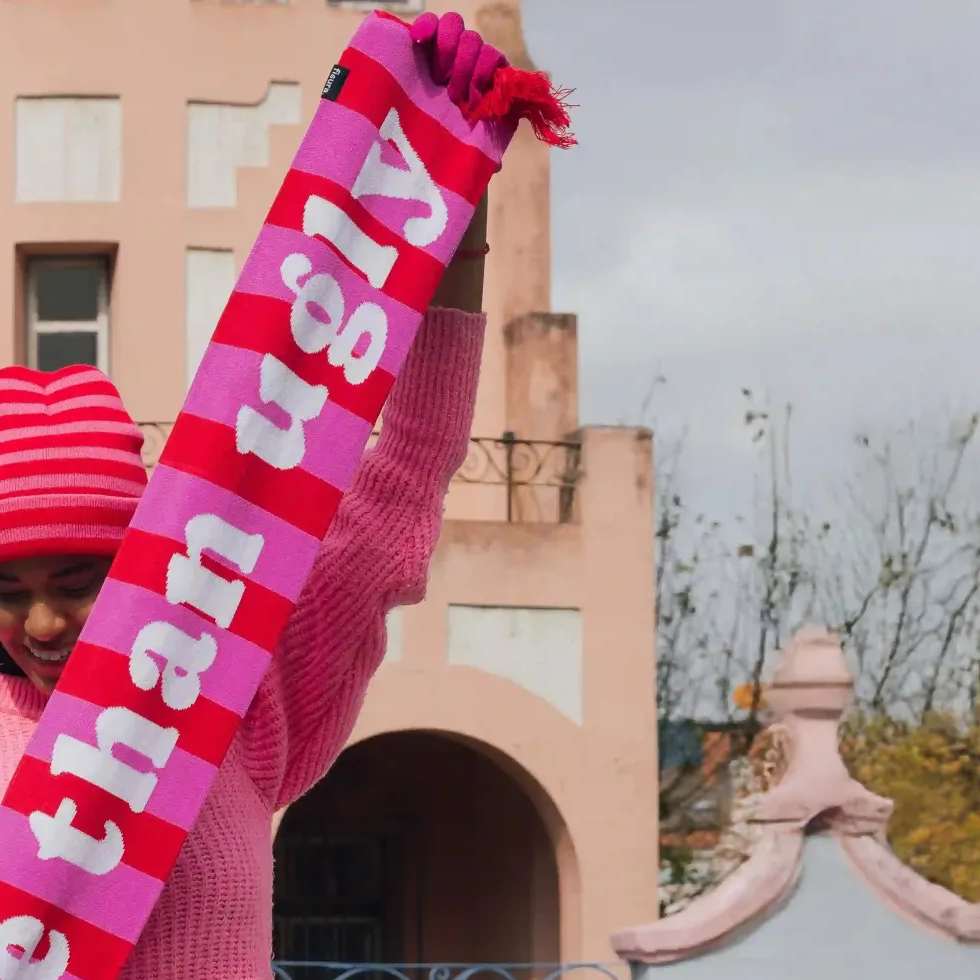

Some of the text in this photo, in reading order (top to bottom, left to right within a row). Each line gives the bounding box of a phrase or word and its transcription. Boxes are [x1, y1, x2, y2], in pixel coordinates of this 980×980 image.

[323, 67, 341, 93] fisura
[30, 513, 265, 876] than
[236, 107, 448, 470] ugly
